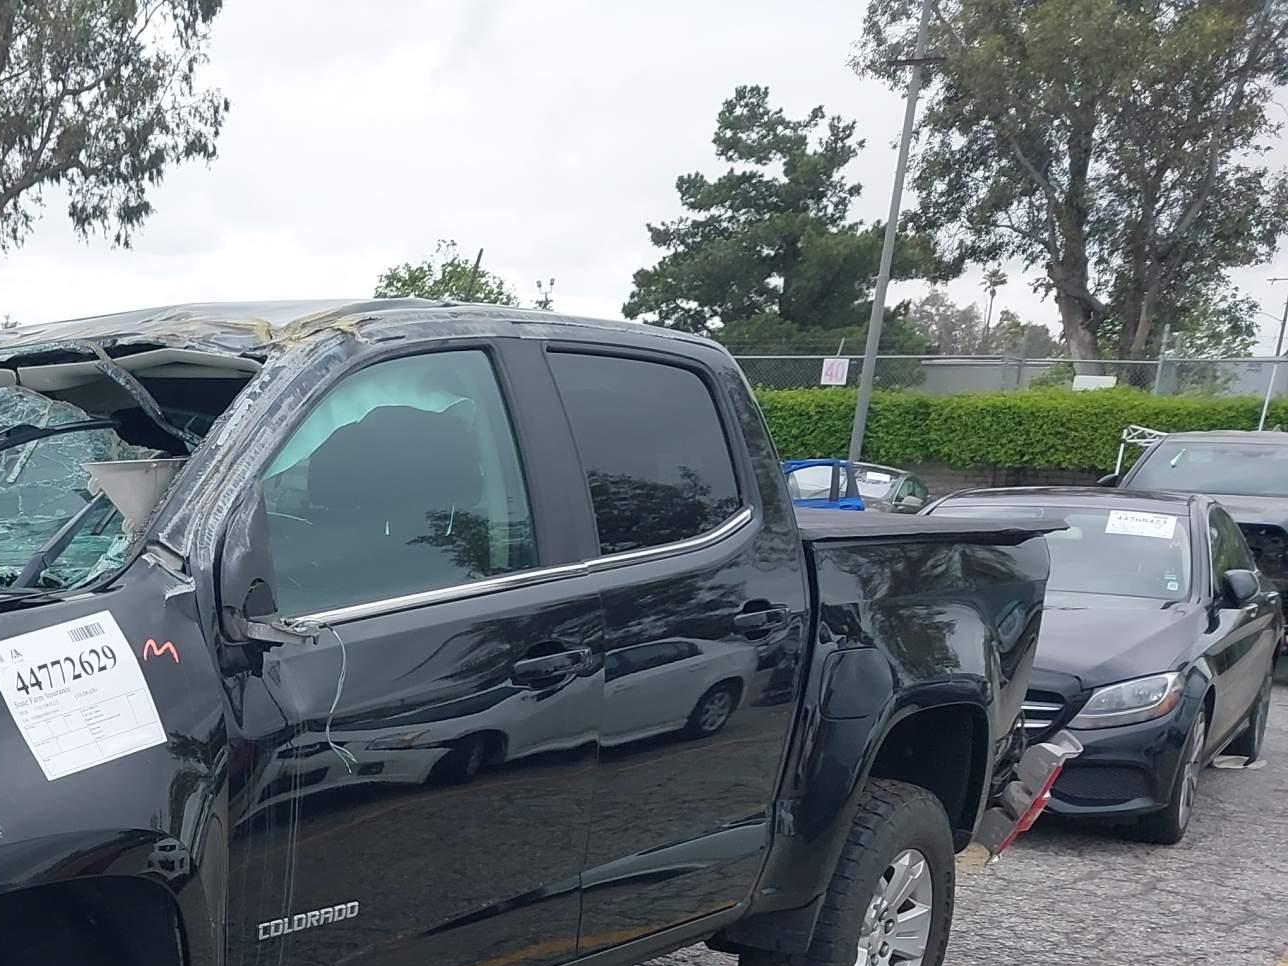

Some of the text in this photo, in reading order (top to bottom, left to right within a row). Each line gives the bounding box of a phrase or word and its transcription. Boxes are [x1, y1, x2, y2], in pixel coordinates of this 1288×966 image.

[824, 361, 846, 381] 40
[16, 645, 116, 695] 44772629
[28, 695, 45, 705] Farm
[258, 901, 359, 940] COLORADO
